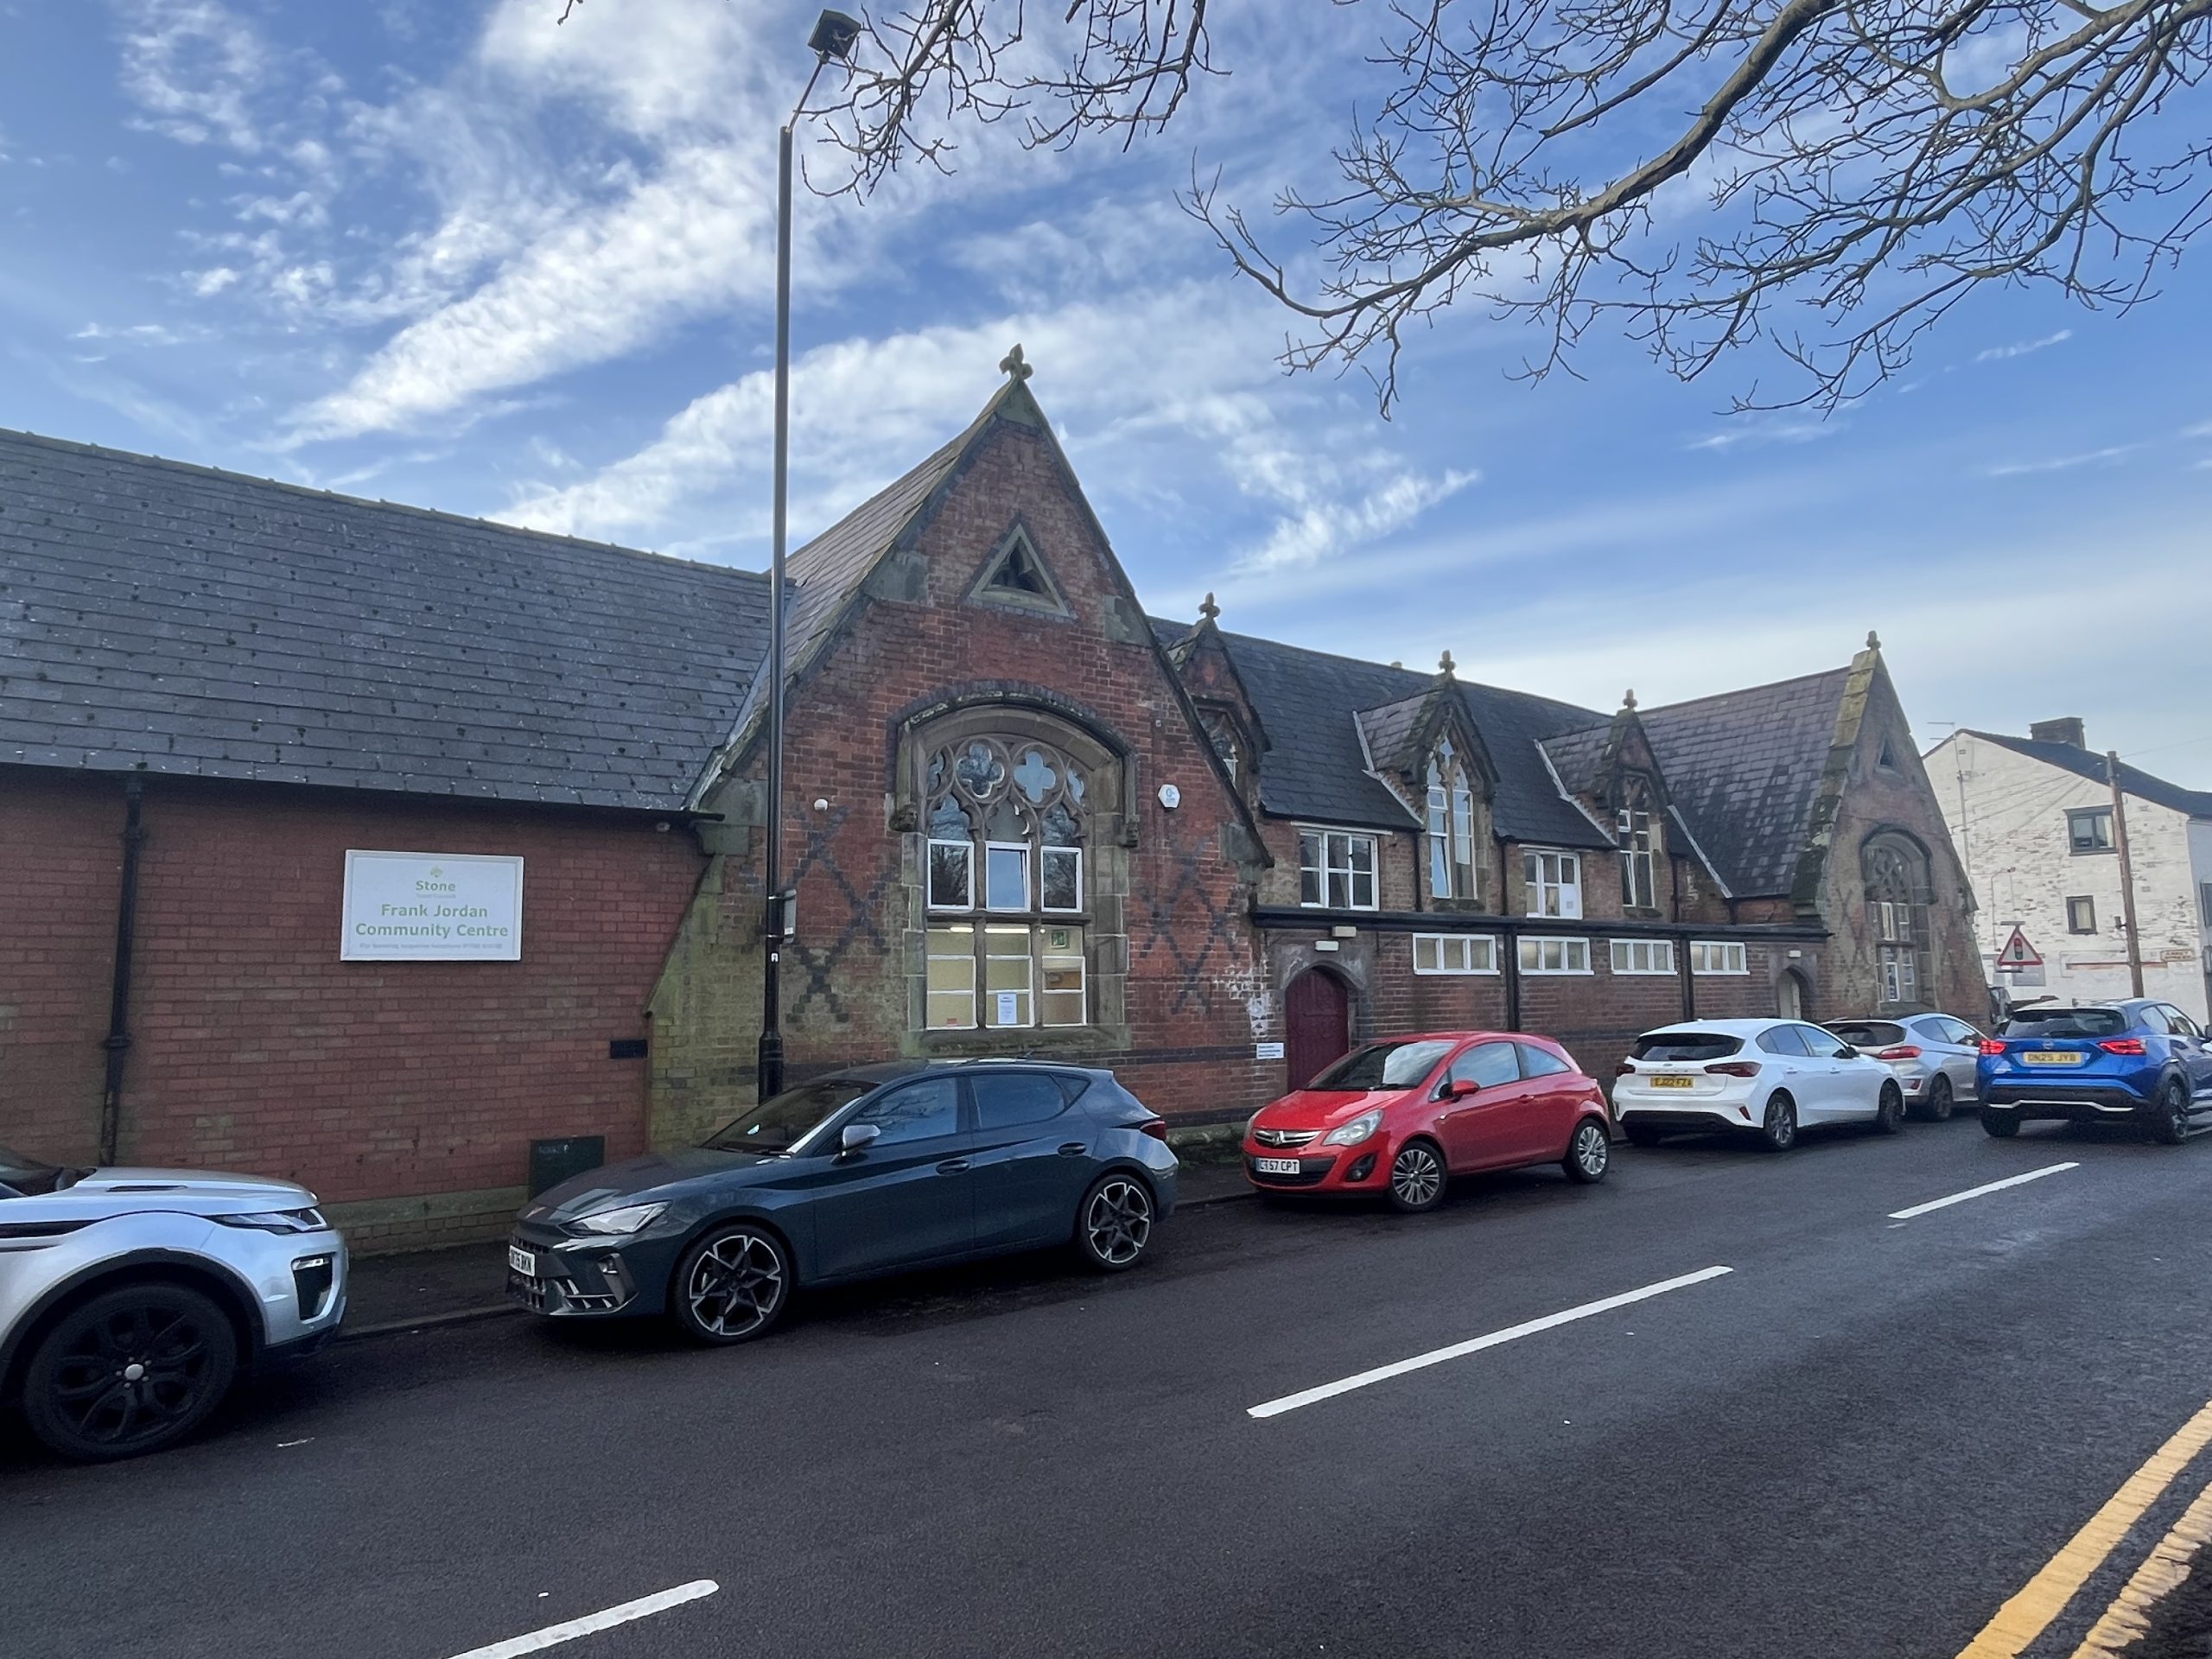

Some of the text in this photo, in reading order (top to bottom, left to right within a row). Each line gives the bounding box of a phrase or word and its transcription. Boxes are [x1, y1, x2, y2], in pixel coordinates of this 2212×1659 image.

[416, 880, 456, 892] Stone
[381, 904, 488, 918] Frank Jordan
[355, 923, 508, 938] Community Centre
[1281, 1160, 1298, 1172] CPT
